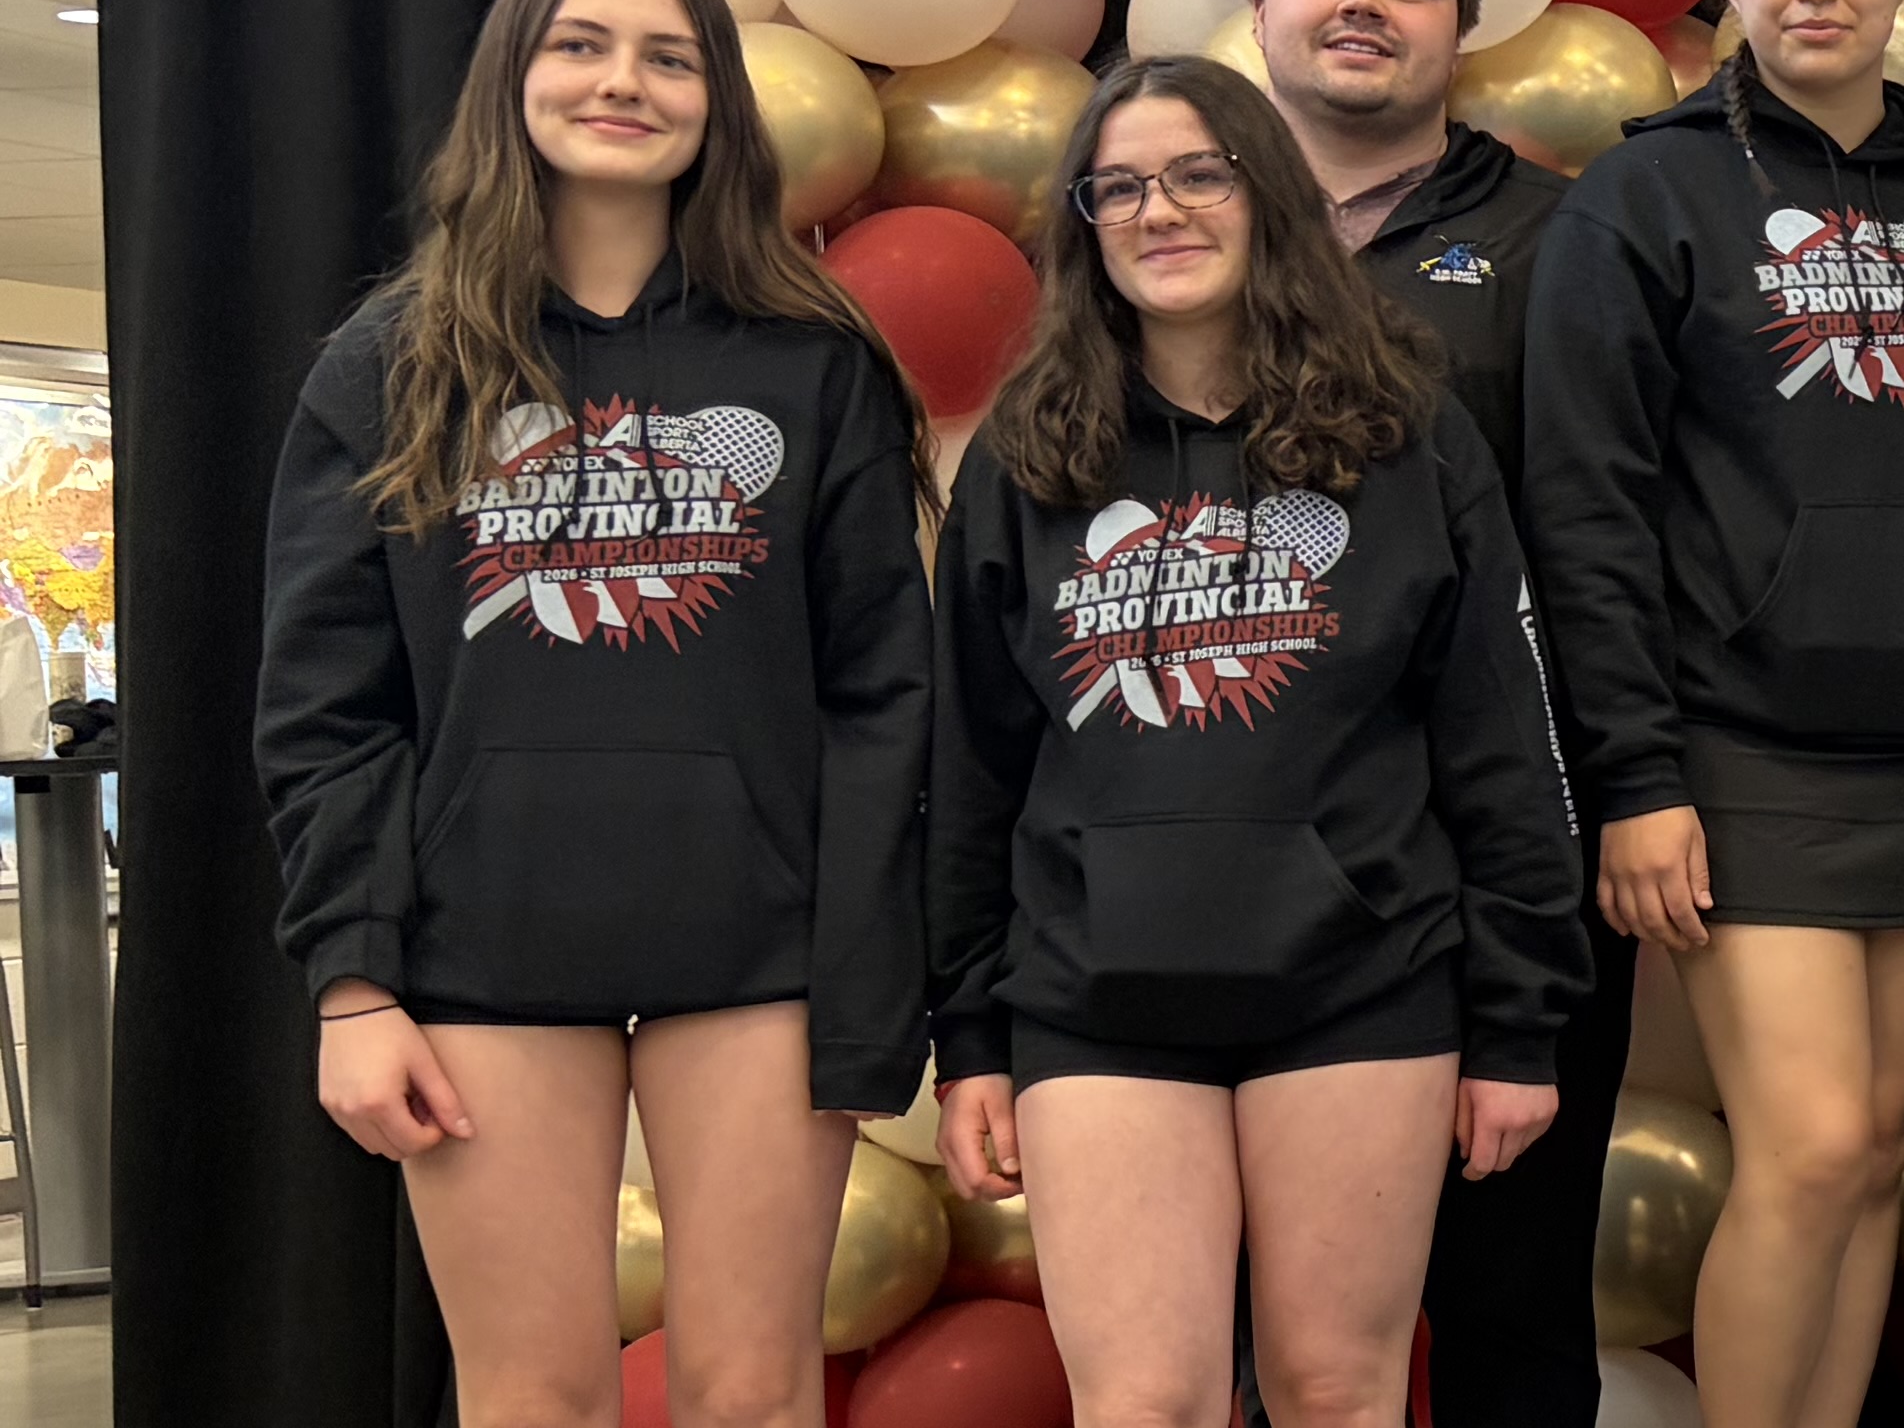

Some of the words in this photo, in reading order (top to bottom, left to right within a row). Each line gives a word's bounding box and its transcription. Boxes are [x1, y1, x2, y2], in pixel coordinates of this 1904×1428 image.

[543, 569, 578, 581] 2026
[589, 567, 607, 580] ST
[608, 564, 659, 579] JOSEPH
[660, 561, 696, 577] HIGH
[698, 560, 742, 575] SCHOOL
[1189, 644, 1234, 662] JOSEPH
[1236, 641, 1269, 656] HIGH
[1270, 637, 1317, 652] SCHOOL
